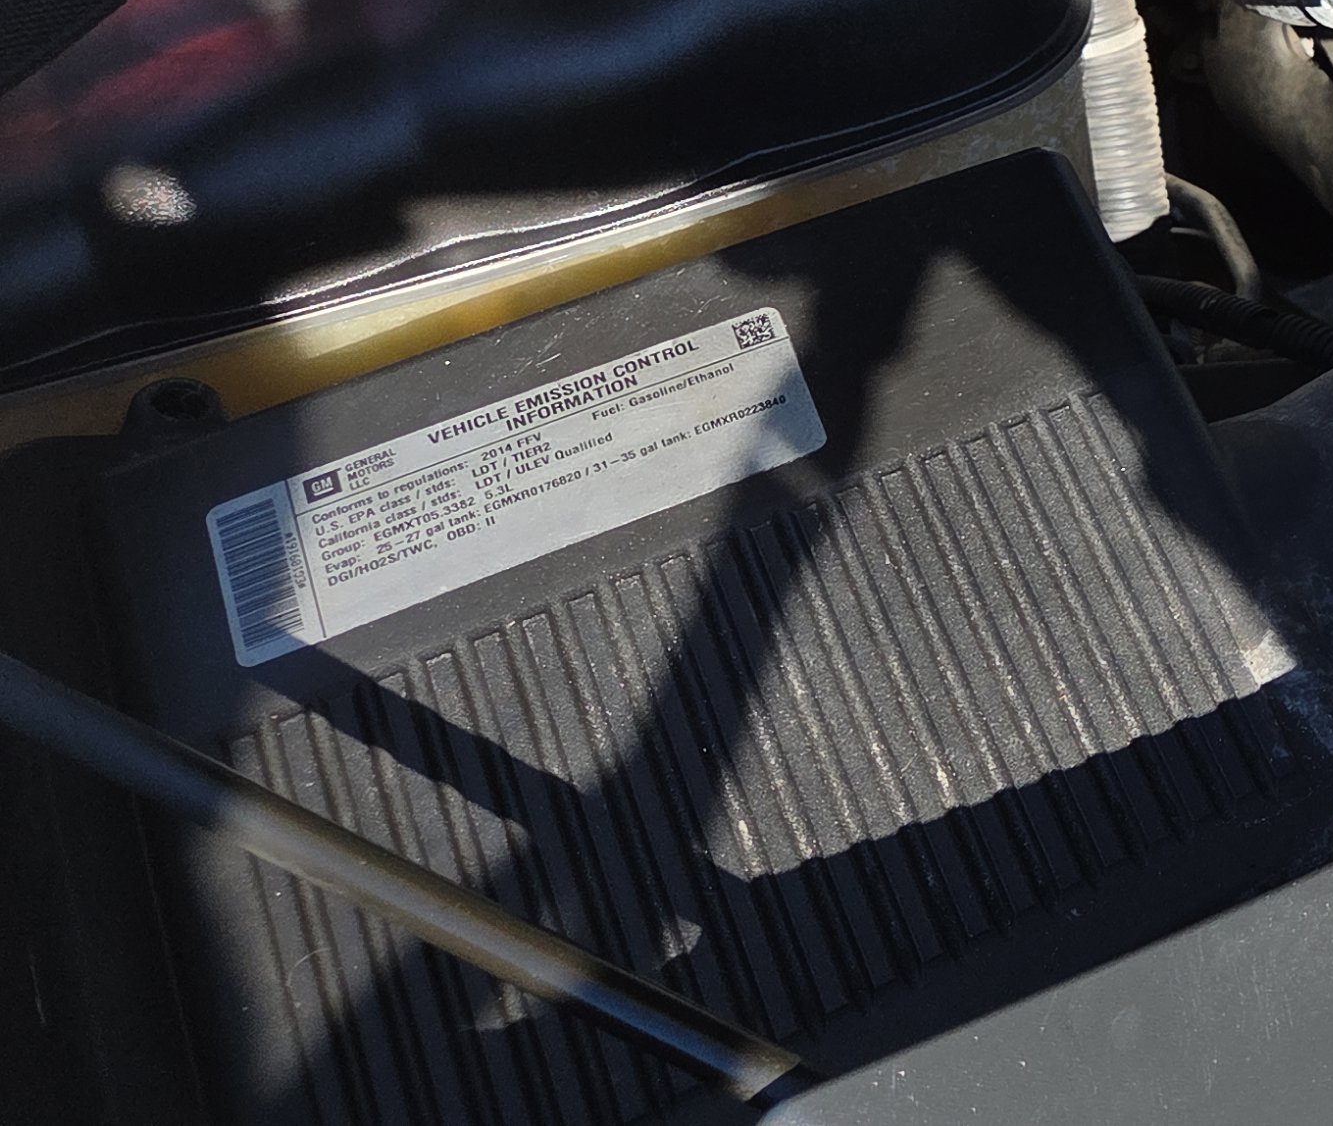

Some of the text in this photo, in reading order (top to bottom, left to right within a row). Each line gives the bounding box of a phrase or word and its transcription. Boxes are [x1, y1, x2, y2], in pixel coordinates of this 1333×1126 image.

[427, 340, 700, 444] VEHICLE EMISSION CONTROL
[505, 374, 638, 432] INFORMATION
[591, 362, 734, 421] Fuel: Gasoline/Ethanol
[311, 432, 541, 525] Conforms to regulations: 2014 FFV
[311, 476, 333, 493] GM
[314, 520, 344, 537] U.S.
[347, 507, 376, 525] EPA
[379, 494, 412, 513] class
[424, 478, 456, 496] stds:
[471, 460, 498, 478] LDT
[511, 441, 552, 463] TIER2
[318, 520, 381, 549] California
[384, 506, 418, 525] class
[430, 489, 462, 507] stds:
[474, 472, 501, 490] LDT
[514, 454, 550, 475] ULEV
[554, 431, 613, 461] Qualified
[324, 554, 361, 574] Evap:
[425, 521, 445, 538] gal
[447, 509, 482, 528] tank:
[483, 470, 582, 514] EGMXR0176820
[639, 441, 659, 457] gal
[660, 431, 692, 448] tank:
[694, 392, 789, 435] EGMXR0223840
[344, 448, 397, 473] GENERAL
[346, 457, 395, 482] MOTORS
[348, 476, 371, 491] LLC
[321, 483, 514, 562] Group: EGMXT05.3382 5.3L
[327, 515, 496, 587] DGI/HO2S/TWC, OBD: II
